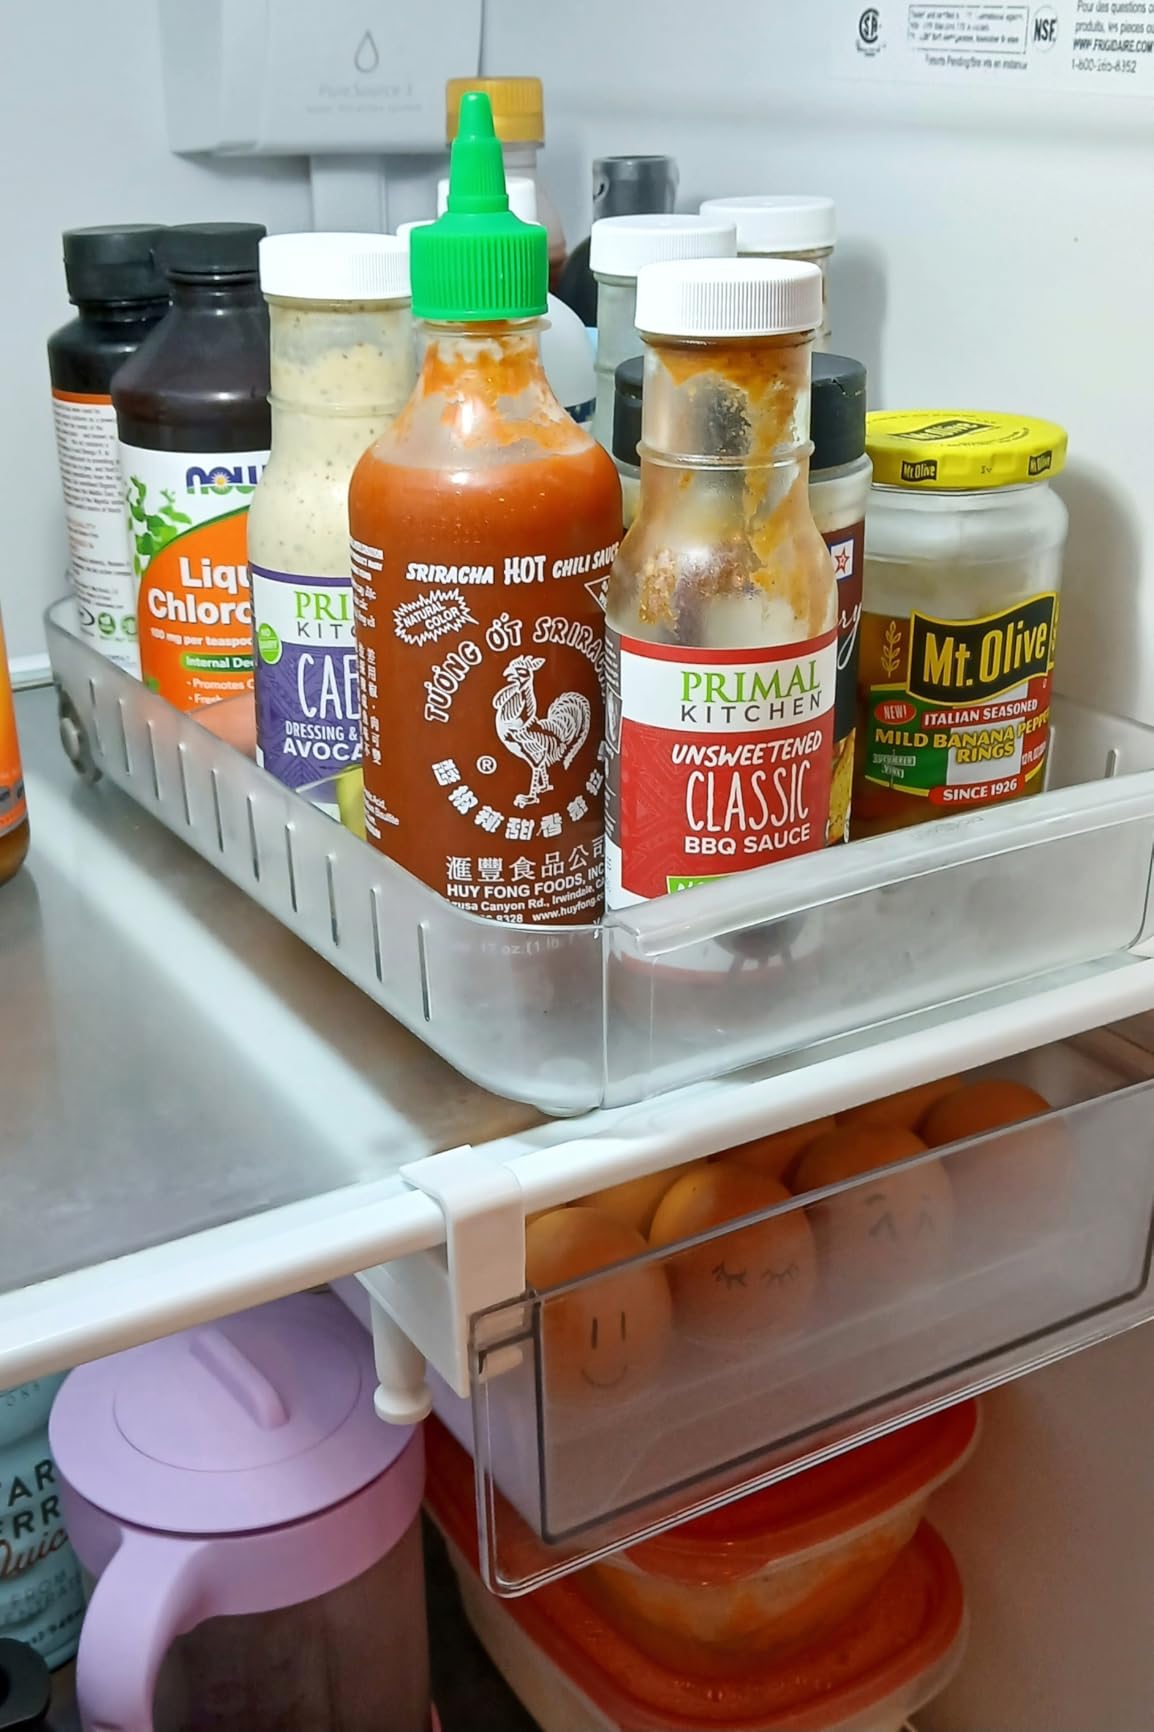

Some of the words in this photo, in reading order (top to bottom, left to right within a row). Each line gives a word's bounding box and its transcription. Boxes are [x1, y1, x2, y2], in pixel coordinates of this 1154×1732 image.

[915, 463, 936, 479] Olive
[406, 563, 494, 584] SRIRACHA
[504, 555, 546, 585] HOT
[552, 555, 590, 579] CHILI
[404, 601, 447, 628] NATURAL
[425, 606, 461, 631] COLOR
[186, 656, 230, 668] Internal
[923, 632, 973, 687] Mt.
[979, 620, 1047, 683] Olive
[192, 678, 245, 690] Promotes
[680, 660, 821, 703] PRIMAL
[681, 691, 822, 723] KITCHEN
[884, 704, 907, 720] NEW!
[924, 710, 980, 726] ITALIAN
[983, 699, 1038, 720] SEASONED
[286, 720, 344, 741] DRESSING
[348, 727, 358, 741] &
[875, 728, 929, 748] MILD
[933, 725, 1014, 749] BANANA
[672, 730, 823, 767] UNSWEETENED
[956, 742, 1015, 764] RINGS
[686, 760, 811, 832] CLASSIC
[943, 785, 987, 801] SINCE
[991, 778, 1018, 796] 1926
[684, 836, 736, 855] BBQ
[744, 823, 811, 853] SAUCE
[446, 884, 480, 898] HUY
[484, 884, 531, 899] FONG
[534, 873, 586, 896] FOODS,
[481, 901, 525, 913] Canyon
[552, 885, 594, 905] Irwindale,
